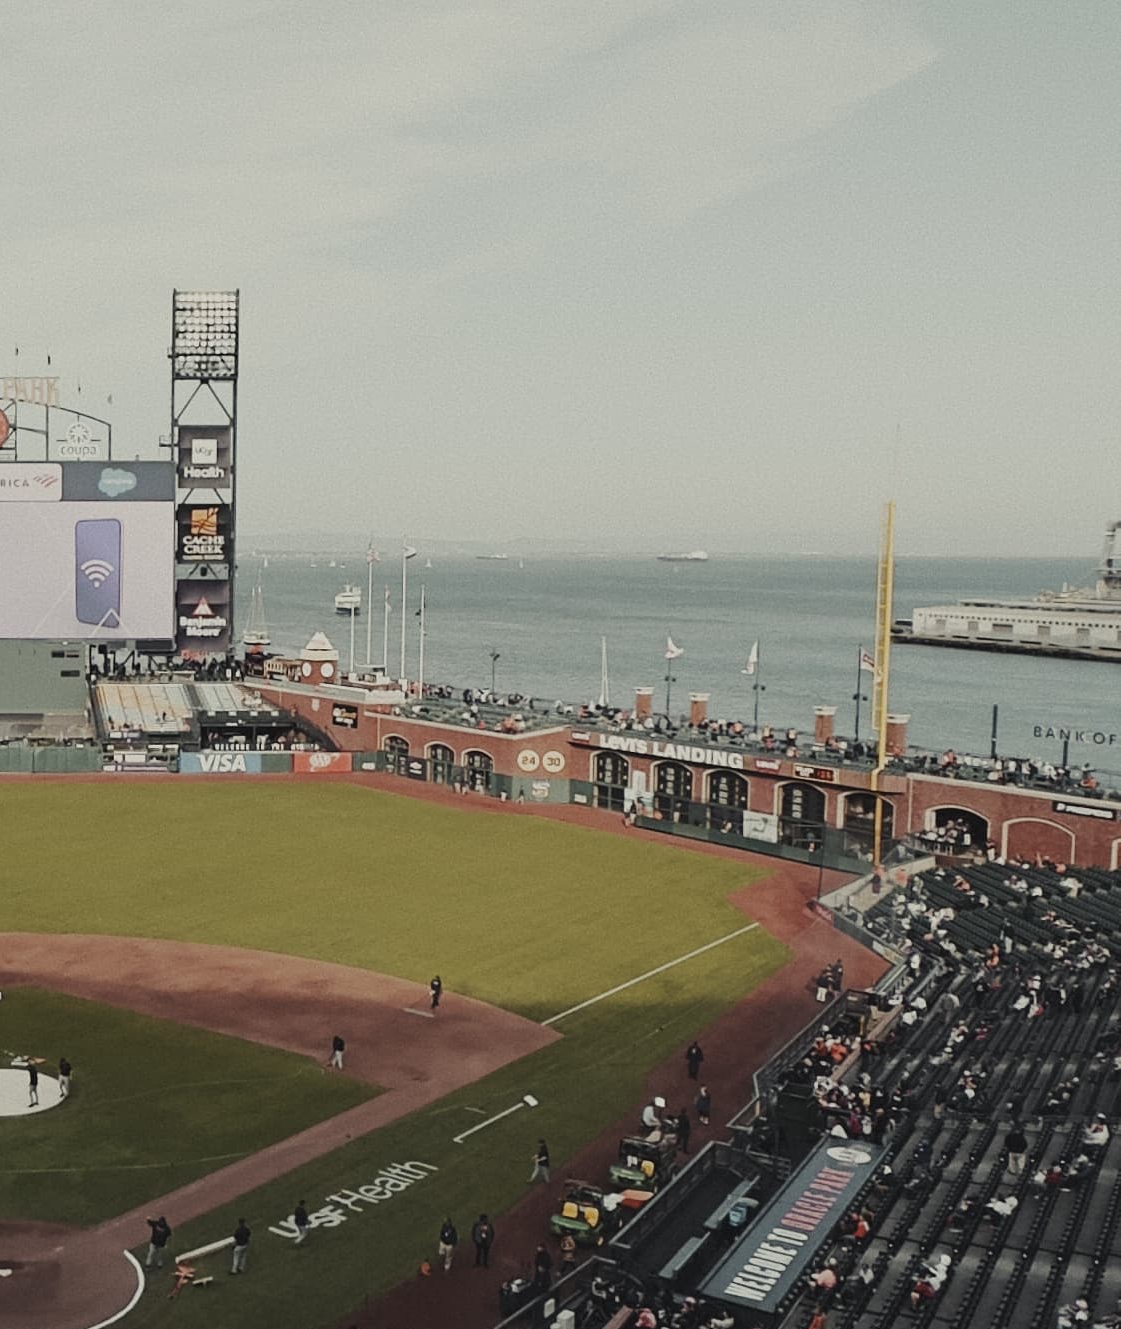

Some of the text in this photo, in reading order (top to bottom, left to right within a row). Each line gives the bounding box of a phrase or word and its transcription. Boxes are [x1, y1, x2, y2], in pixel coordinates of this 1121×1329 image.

[60, 445, 96, 456] coupa
[183, 466, 225, 479] Health
[183, 536, 225, 545] CACHE
[184, 545, 224, 554] CREEK
[1033, 726, 1117, 745] BANK OF
[197, 754, 246, 772] VISA
[653, 742, 744, 769] LANDING
[325, 1161, 439, 1212] Health
[724, 1167, 855, 1301] WELCOME TO ORACLE PARK
